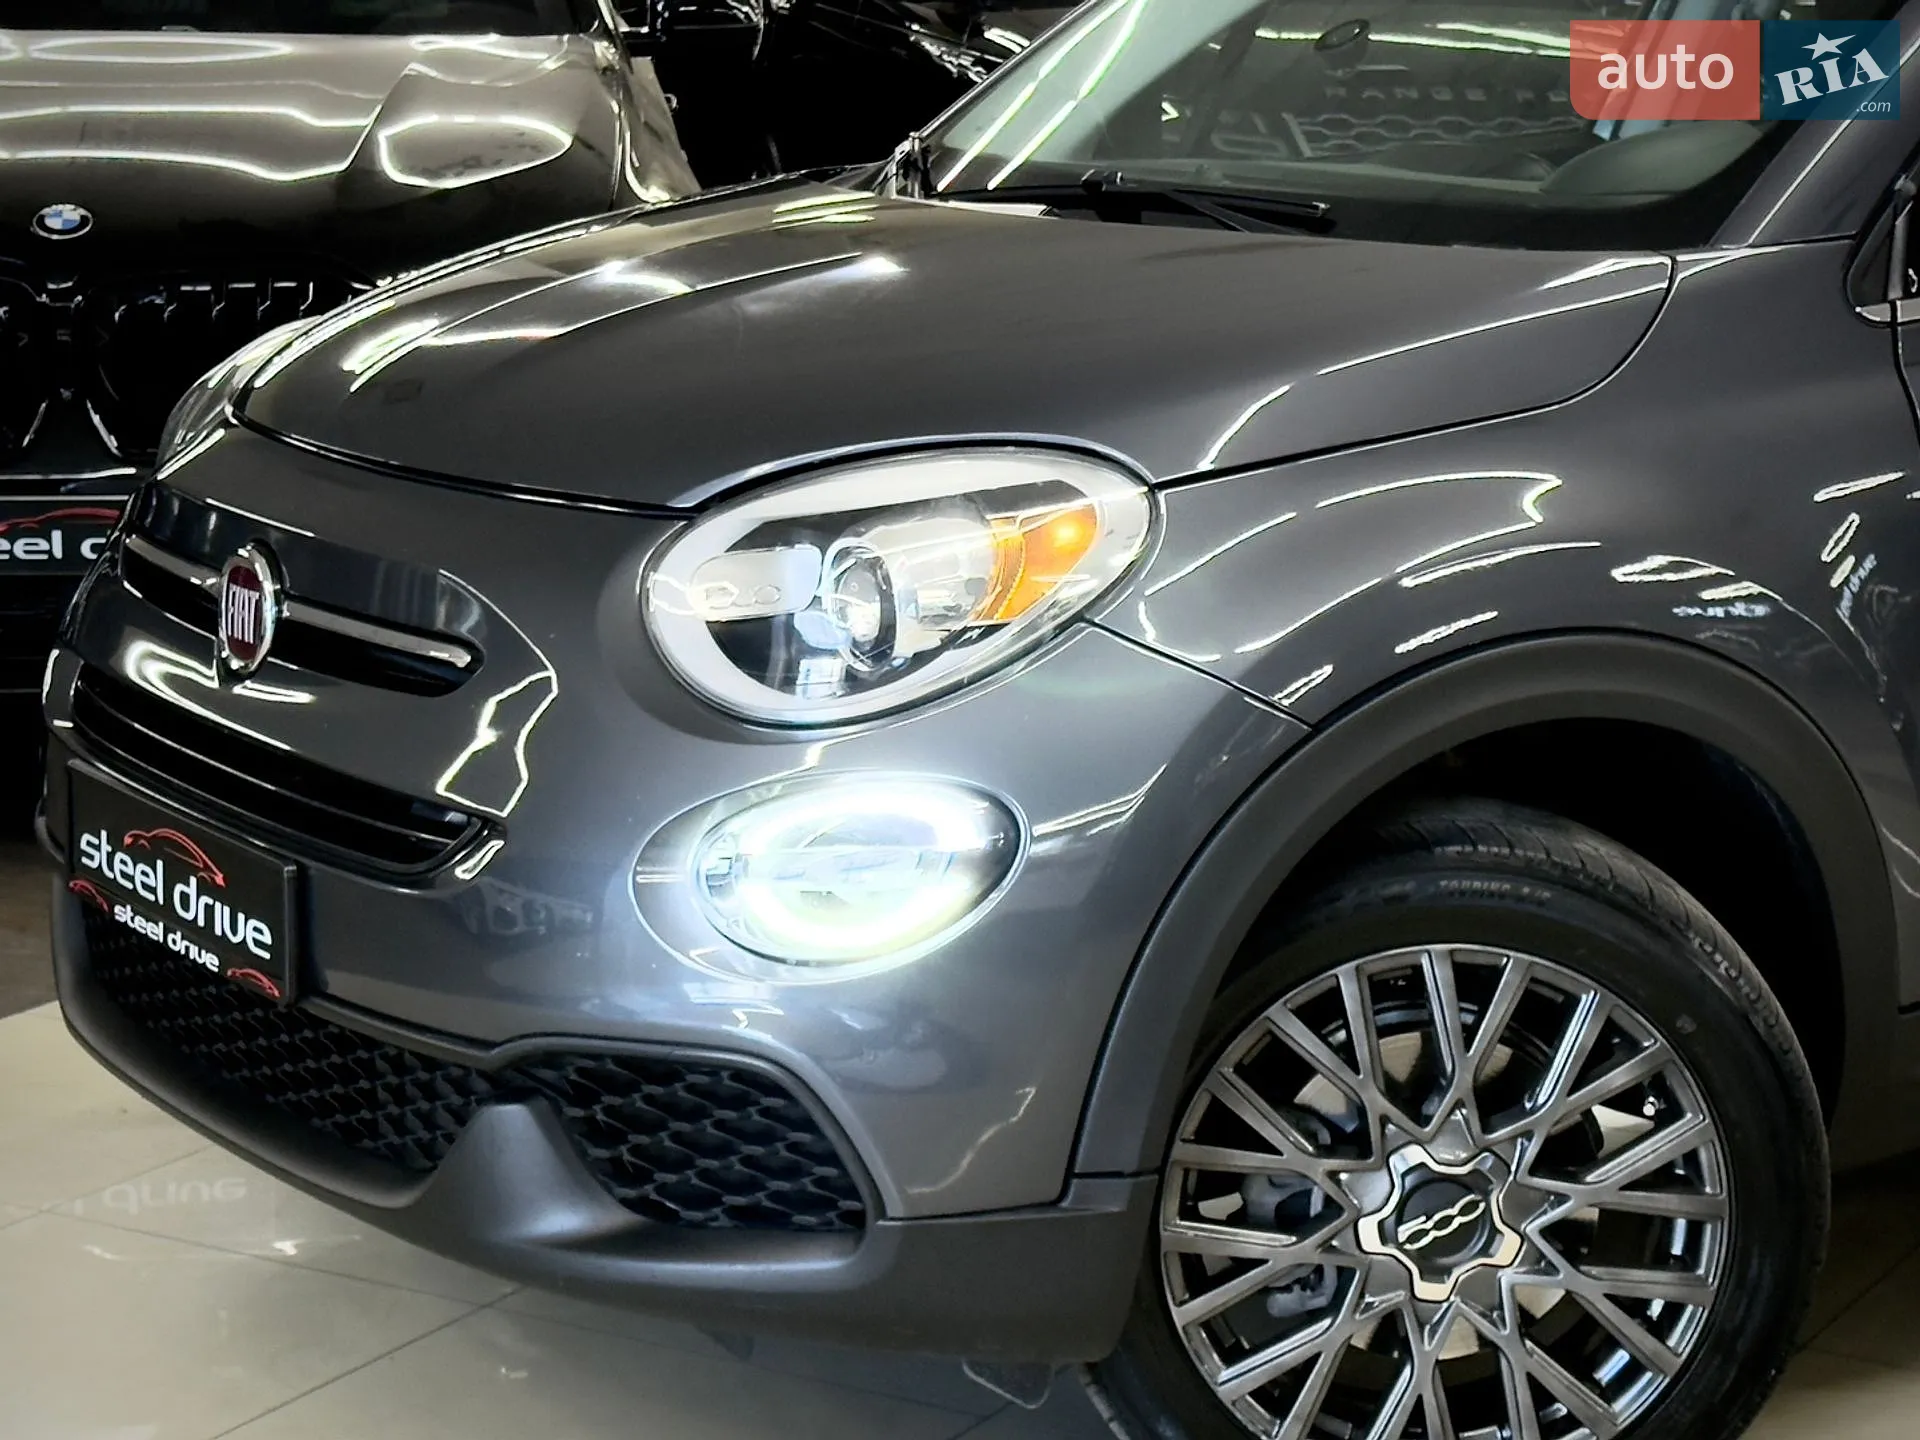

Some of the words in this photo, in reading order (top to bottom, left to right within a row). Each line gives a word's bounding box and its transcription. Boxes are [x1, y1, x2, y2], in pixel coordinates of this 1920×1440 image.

[226, 582, 260, 645] FIAT
[79, 828, 164, 906] steel
[173, 875, 273, 960] drive
[113, 903, 164, 944] steel
[166, 930, 221, 973] drive
[1396, 1193, 1487, 1251] 500
